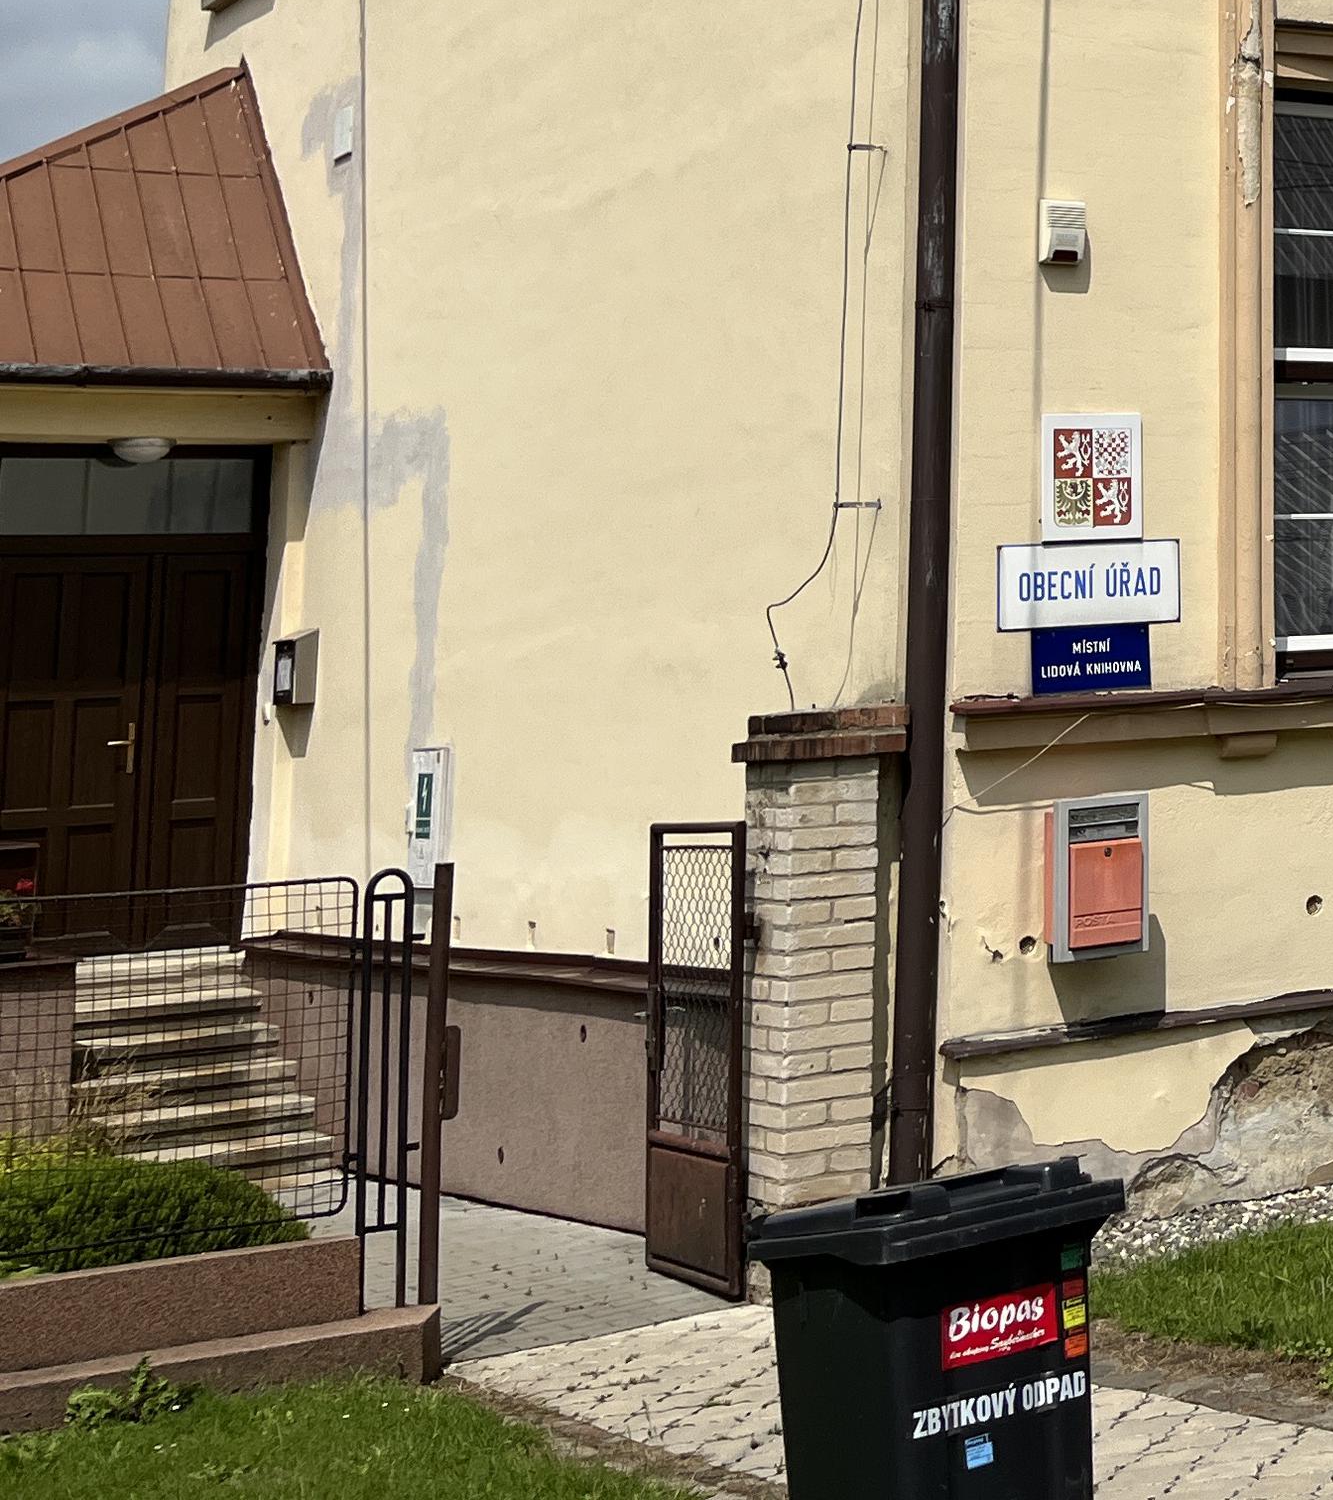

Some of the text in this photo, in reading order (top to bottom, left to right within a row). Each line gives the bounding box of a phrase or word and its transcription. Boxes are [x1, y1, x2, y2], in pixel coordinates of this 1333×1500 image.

[1018, 562, 1162, 602] OBECNÍ ÚŘAD
[1072, 637, 1111, 654] MÍSTNÍ
[1041, 660, 1142, 679] LIDOVÁ KNIHOVNA
[948, 1296, 1045, 1342] Biopas
[912, 1370, 1086, 1440] ZBYTKOVÝ ODPAD
